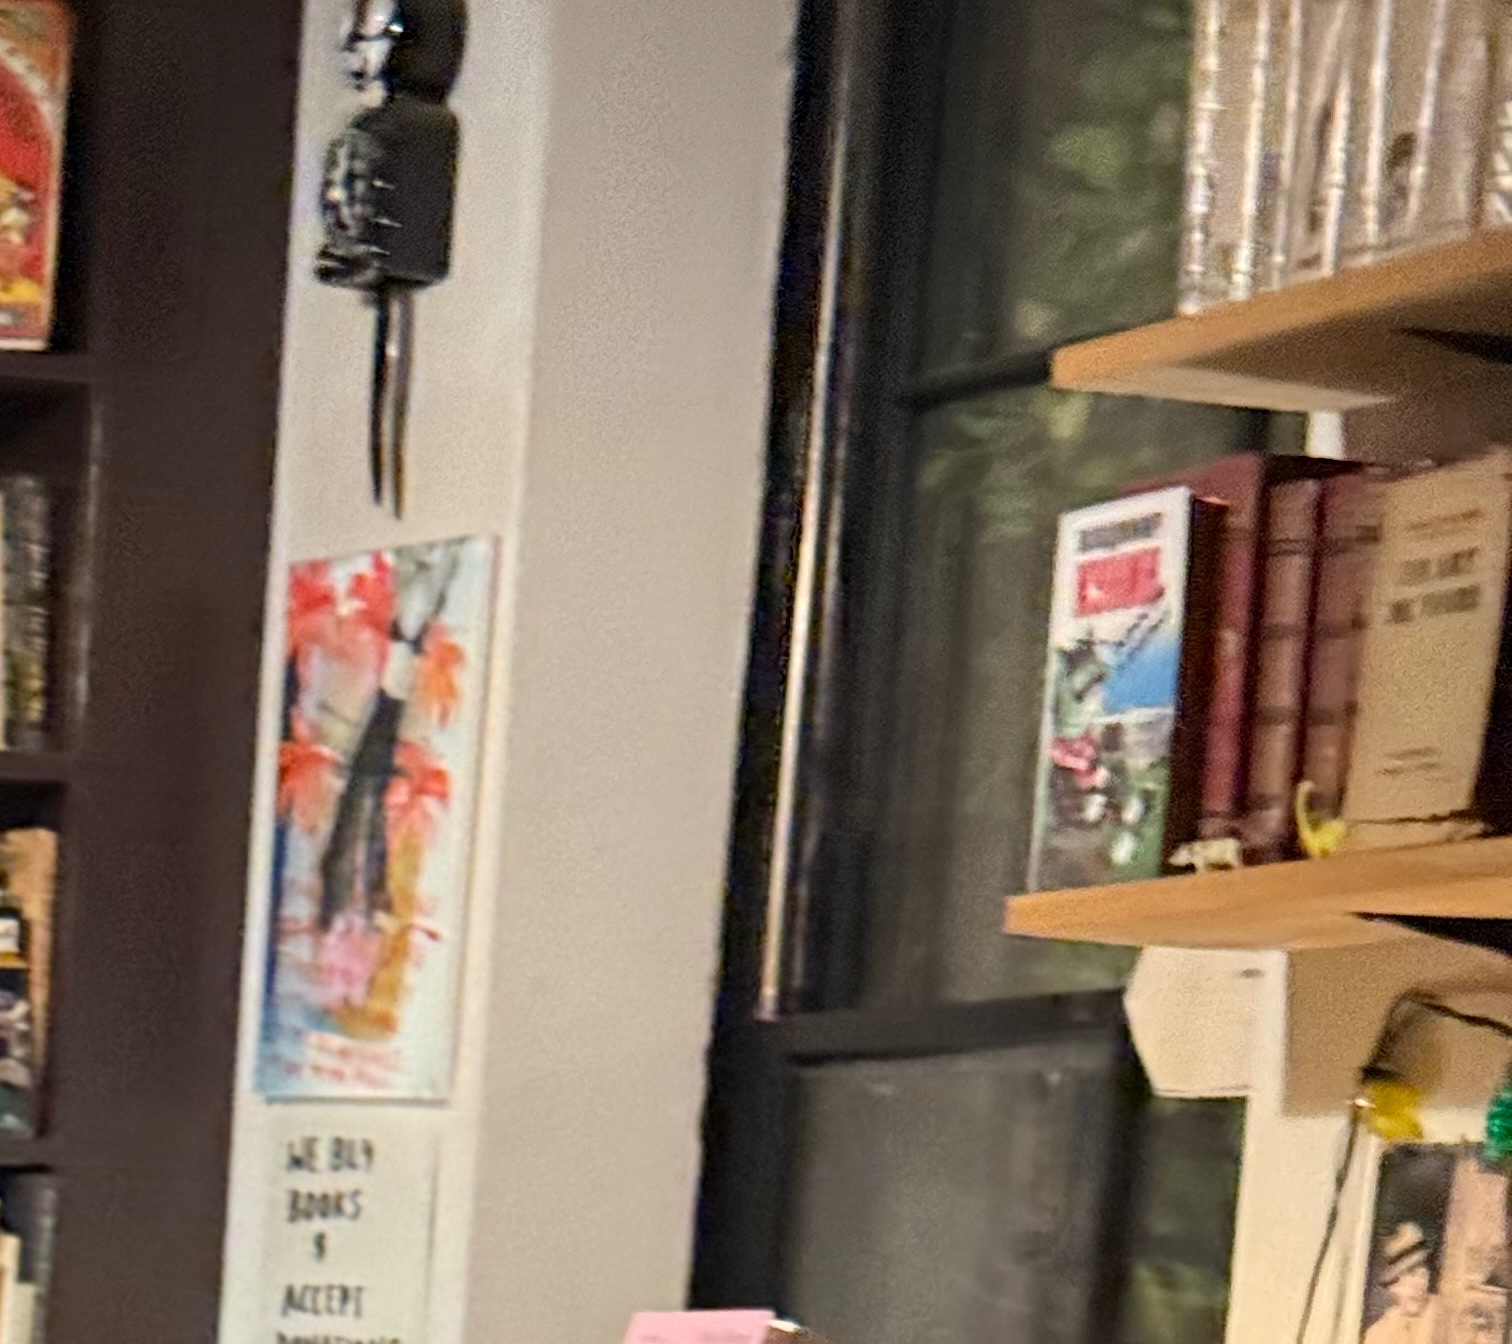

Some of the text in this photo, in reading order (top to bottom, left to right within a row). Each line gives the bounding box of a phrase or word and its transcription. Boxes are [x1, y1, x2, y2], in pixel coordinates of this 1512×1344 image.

[287, 1137, 374, 1173] WE BUY
[287, 1189, 362, 1223] BOOKS
[282, 1283, 364, 1318] ACCEPT
